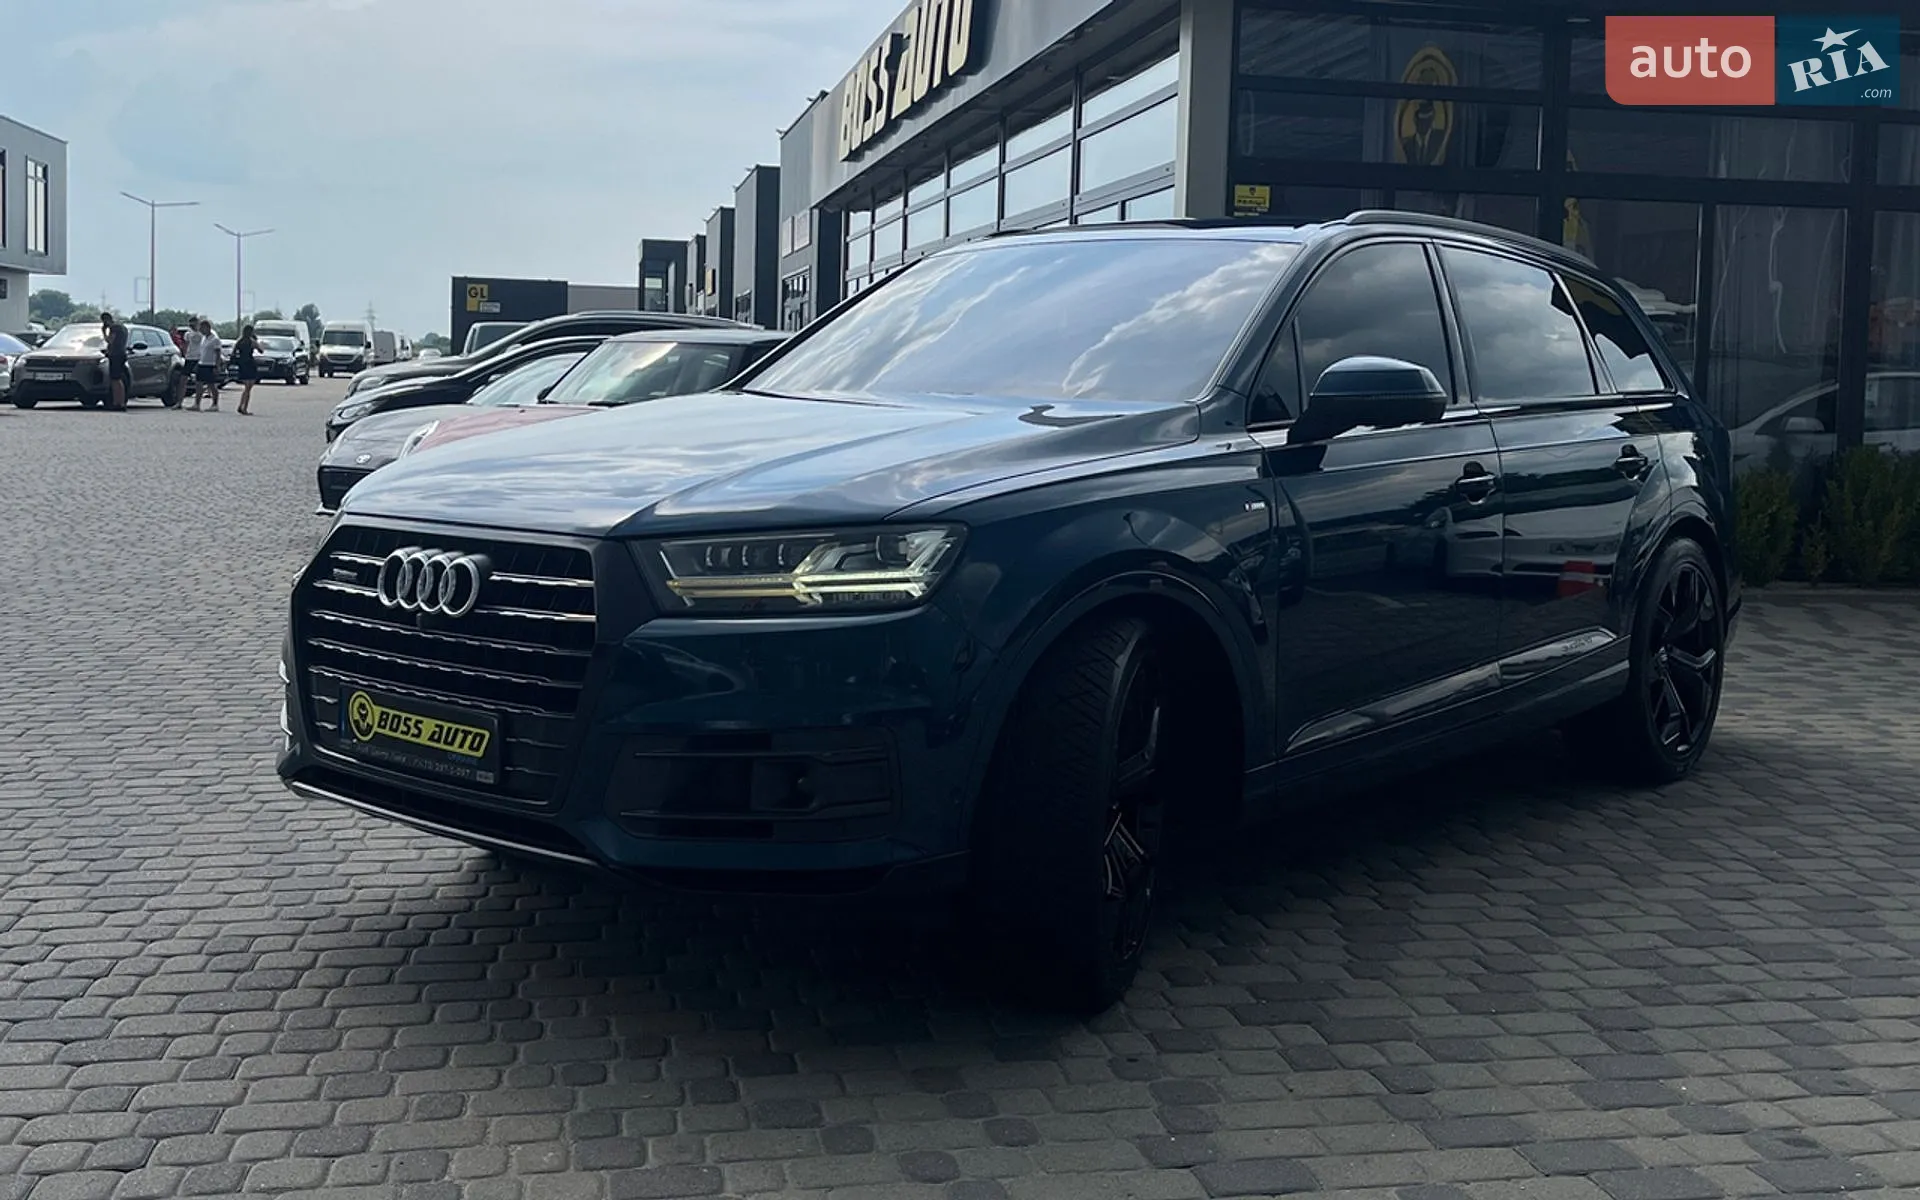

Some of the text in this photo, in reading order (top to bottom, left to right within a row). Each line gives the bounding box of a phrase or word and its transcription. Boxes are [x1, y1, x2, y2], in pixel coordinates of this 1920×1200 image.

[838, 32, 891, 162] BOSS
[468, 286, 486, 299] GL
[377, 710, 486, 753] BOSS AUTO
